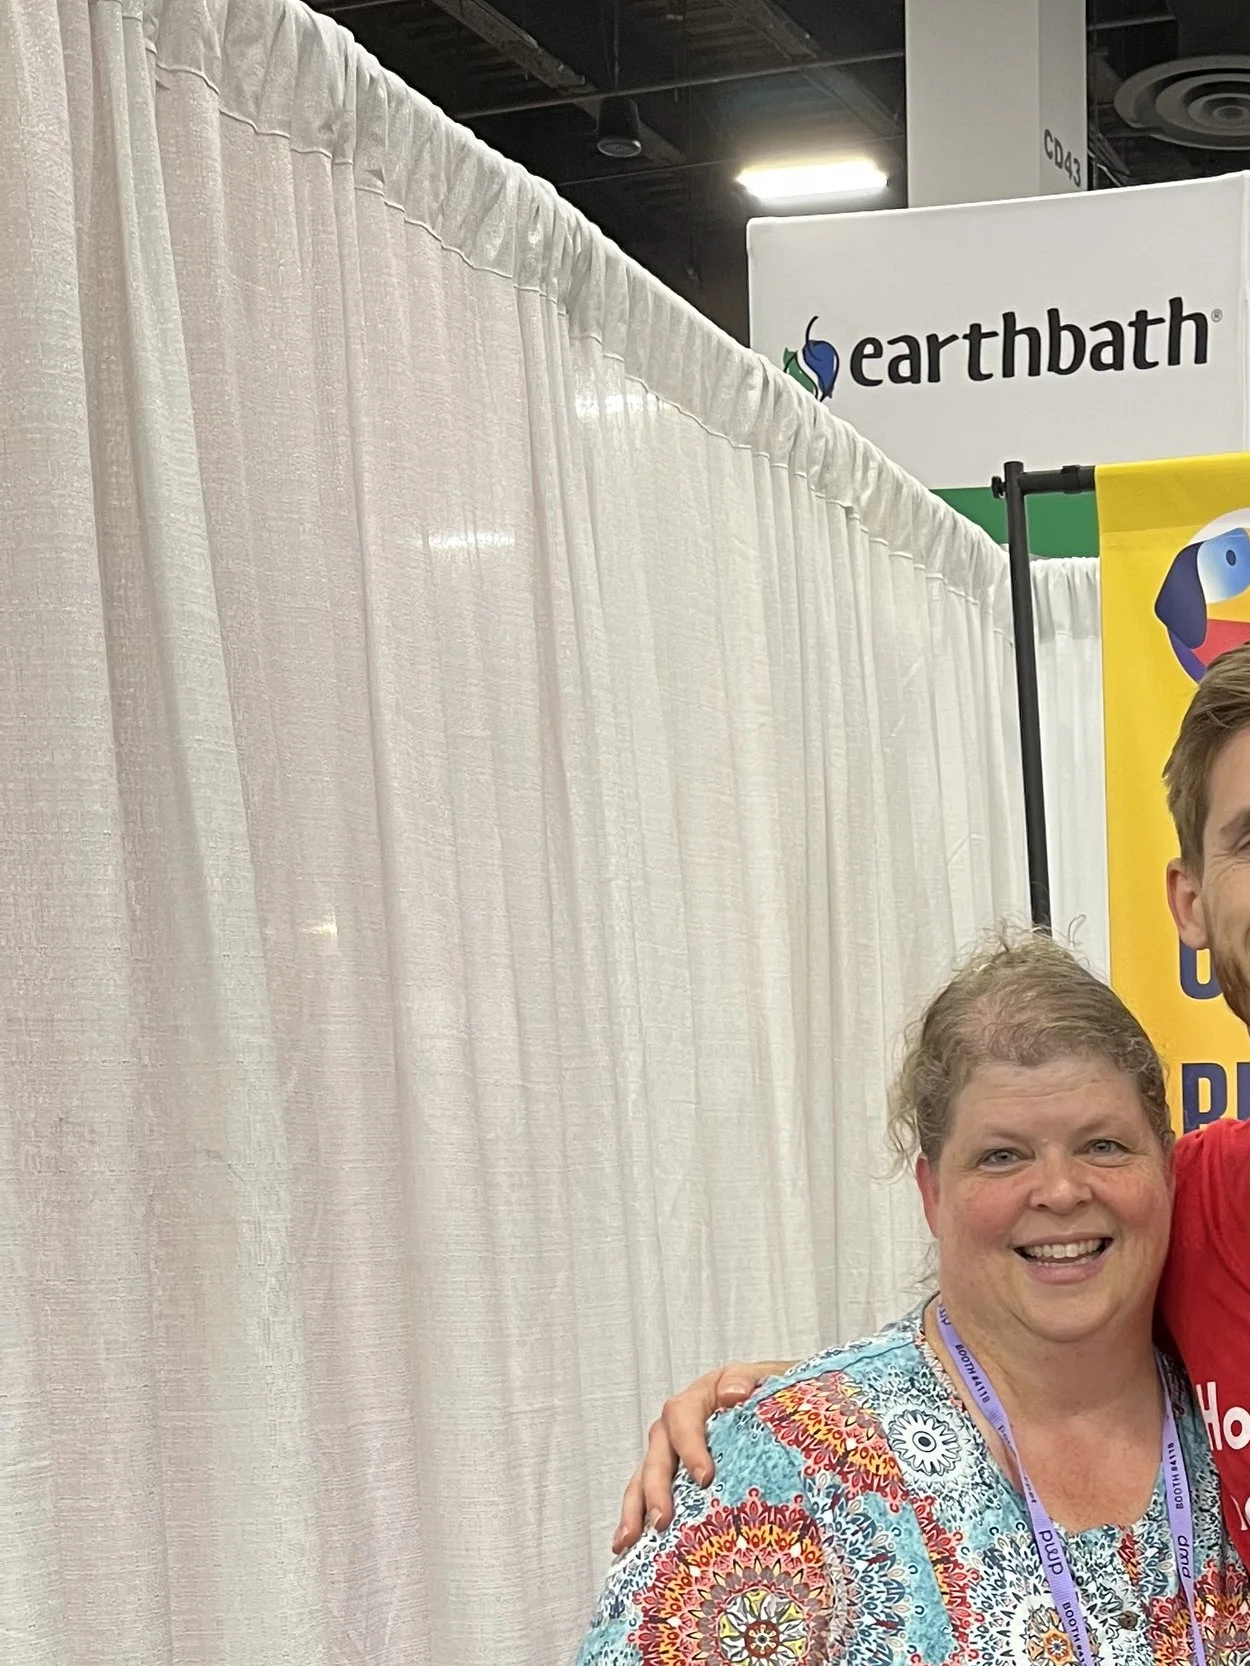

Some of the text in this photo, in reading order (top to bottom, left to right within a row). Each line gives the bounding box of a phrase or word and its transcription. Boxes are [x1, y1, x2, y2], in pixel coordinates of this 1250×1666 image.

[1043, 128, 1081, 188] CD43
[954, 1343, 976, 1375] BOOTH
[1172, 1473, 1185, 1510] BOOTH
[1062, 1602, 1082, 1643] BOOTH
